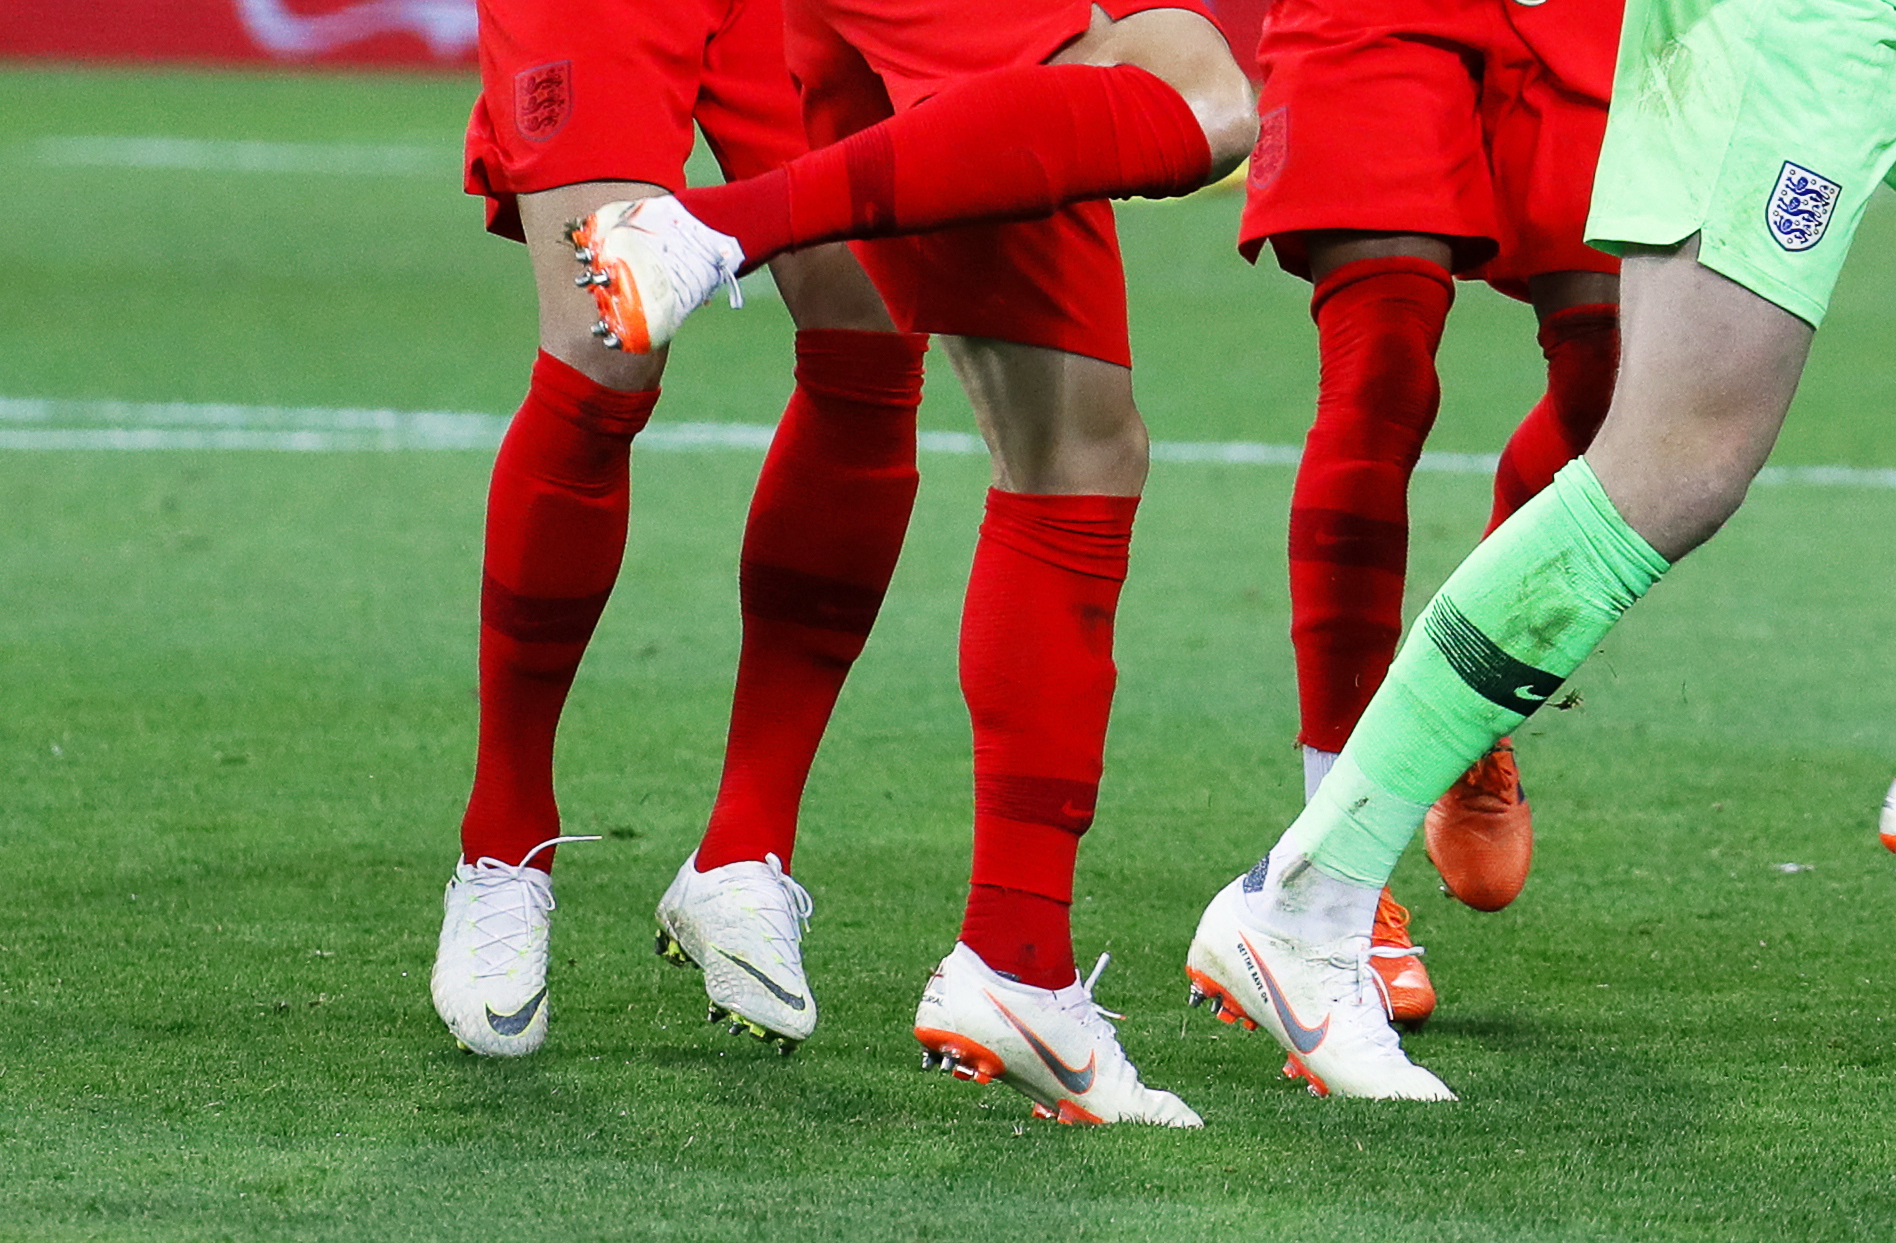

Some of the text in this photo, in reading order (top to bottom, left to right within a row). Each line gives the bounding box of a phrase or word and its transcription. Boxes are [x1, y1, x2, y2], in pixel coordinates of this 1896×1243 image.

[1237, 943, 1248, 957] GET
[1244, 956, 1255, 971] THE
[1251, 971, 1264, 991] RAVE
